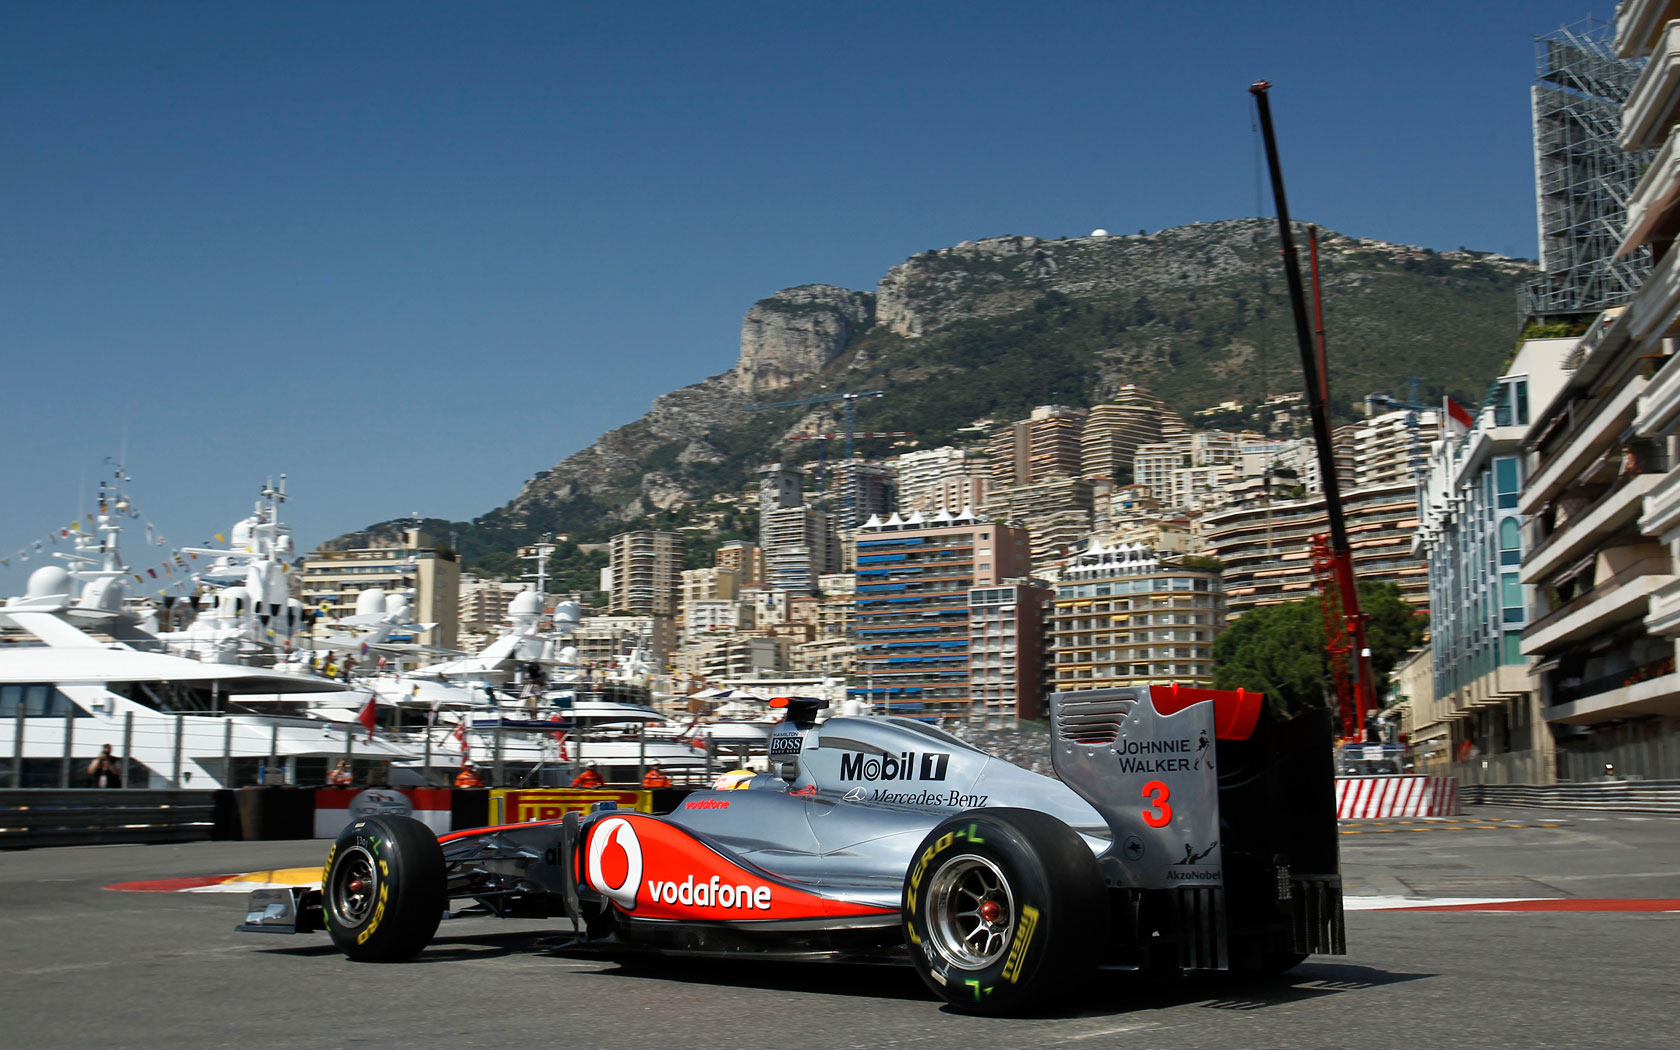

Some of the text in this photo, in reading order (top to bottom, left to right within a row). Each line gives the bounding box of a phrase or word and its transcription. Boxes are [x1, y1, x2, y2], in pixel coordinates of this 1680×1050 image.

[772, 738, 801, 750] BOSS
[1117, 739, 1191, 755] JOHNNIE
[840, 752, 915, 781] Mobil
[1119, 757, 1190, 773] WALKER
[685, 798, 730, 810] vodafone
[870, 788, 989, 808] Mercedes-Benz
[1141, 780, 1173, 828] 3
[907, 831, 955, 915] ZERO
[1167, 870, 1221, 881] AkzoNobel
[357, 860, 389, 945] P ZERO
[648, 875, 772, 910] vodafone
[908, 922, 922, 945] P
[1001, 904, 1040, 984] PIRELLI
